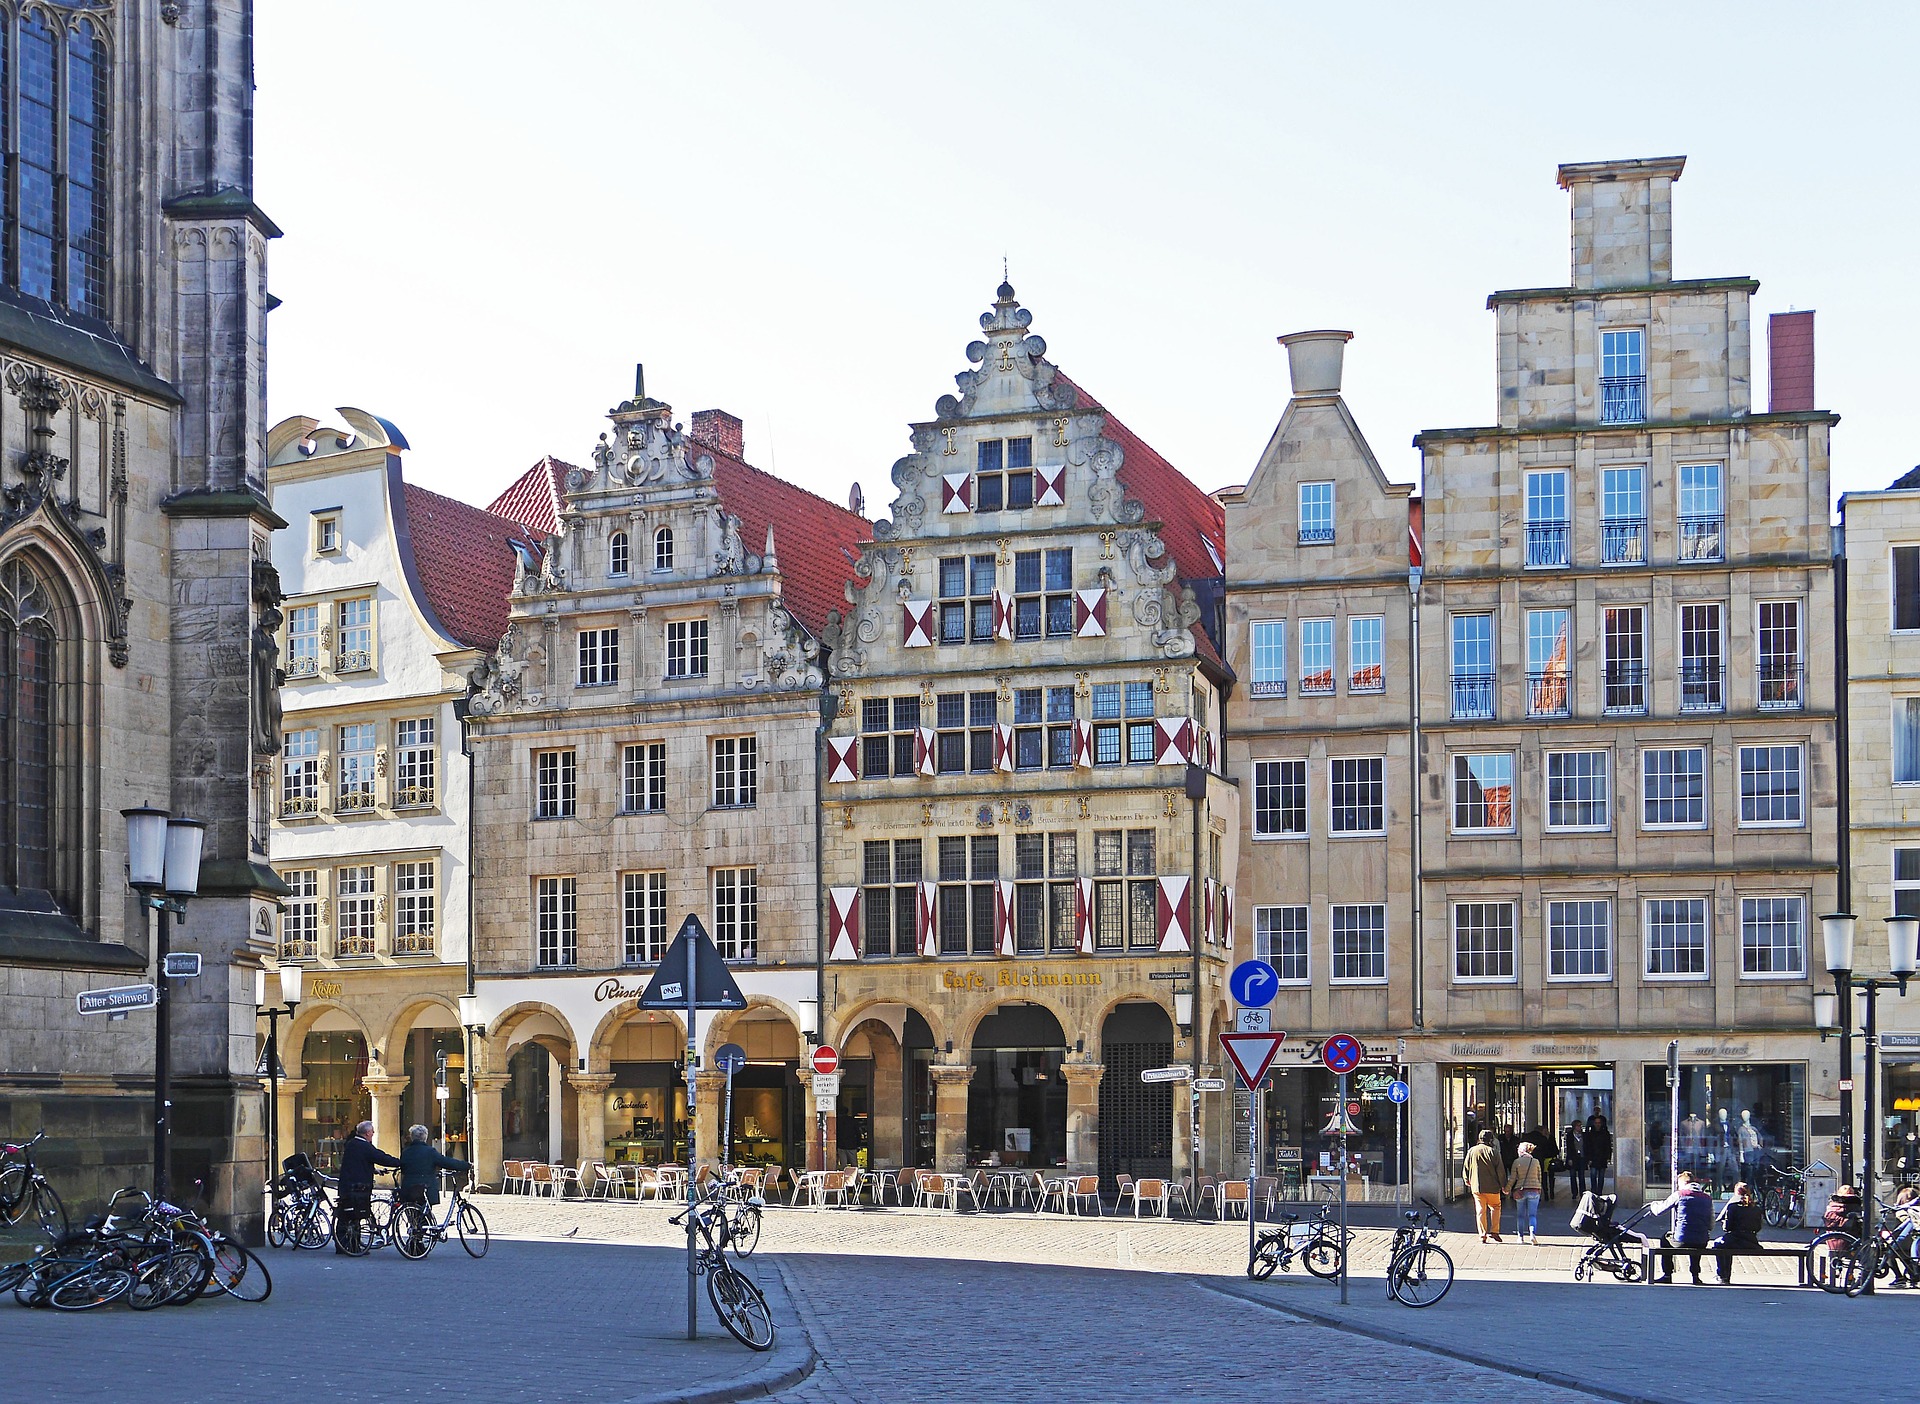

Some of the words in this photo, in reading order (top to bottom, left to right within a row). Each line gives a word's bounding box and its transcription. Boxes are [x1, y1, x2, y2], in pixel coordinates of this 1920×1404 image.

[943, 969, 985, 992] Cafe
[997, 966, 1103, 987] Kleimann
[83, 997, 107, 1008] Alter
[109, 992, 148, 1006] Steinweg
[594, 978, 643, 1002] Rüsch
[1891, 1036, 1918, 1044] Drubbel
